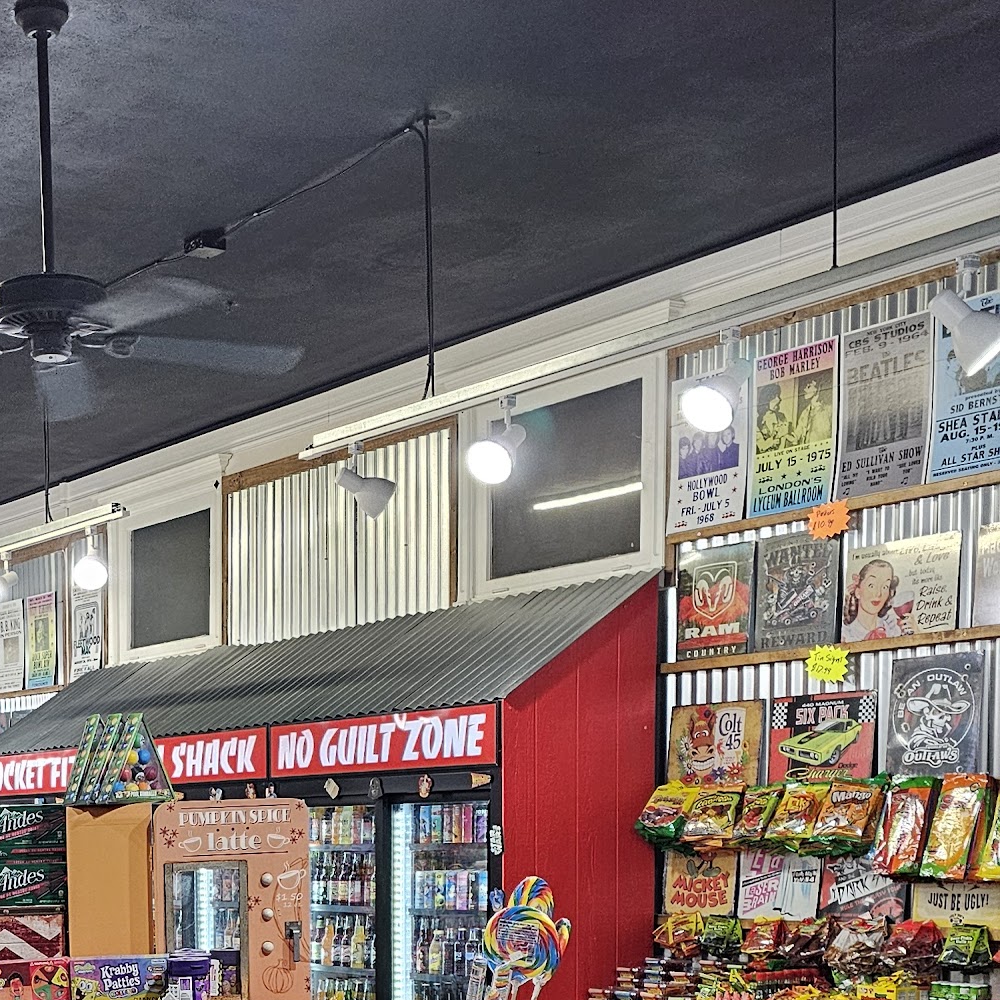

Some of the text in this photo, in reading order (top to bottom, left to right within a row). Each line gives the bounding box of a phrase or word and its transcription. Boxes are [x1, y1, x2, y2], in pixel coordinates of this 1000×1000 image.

[845, 346, 873, 358] FEB.
[898, 329, 930, 344] 1964
[848, 321, 925, 350] CBS STUDIOS
[756, 340, 835, 371] GEORGE HARRISON
[769, 357, 820, 381] BOB MARLEY
[847, 350, 927, 382] BEATLES
[950, 402, 964, 415] SID
[938, 416, 967, 434] SHEA
[940, 430, 969, 443] AUG.
[794, 445, 810, 454] STAGE
[971, 443, 986, 451] PLUS
[756, 449, 831, 474] JULY 15 1975
[842, 445, 924, 473] ED SULLIVAN SHOW
[941, 449, 985, 467] ALL STAR
[687, 473, 728, 492] HOLLYWOOD
[758, 476, 822, 494] LONDON'S
[692, 489, 720, 502] BOWL
[753, 485, 824, 513] LYCEUM BALLROOM
[696, 513, 715, 525] 1968
[914, 551, 950, 566] & Love
[916, 597, 953, 611] Drink &
[917, 610, 952, 625] Repeat
[685, 622, 740, 639] RAM
[761, 629, 829, 648] REWARD
[73, 636, 101, 649] FLEETWOOD
[686, 645, 738, 659] COUNTRY
[927, 671, 966, 697] OUTLAW
[817, 699, 844, 708] MAGNUM
[718, 711, 743, 736] Colt
[795, 703, 850, 726] SIX PACK
[277, 713, 487, 770] NO GUILT ZONE
[724, 732, 741, 750] 45
[171, 735, 257, 779] SHACK
[902, 748, 960, 766] OUTLAWS
[784, 766, 850, 781] Charger
[831, 790, 872, 803] Mango
[0, 810, 44, 834] Andes
[178, 808, 291, 827] PUMPKIN SPICE
[206, 831, 262, 852] latte
[0, 868, 45, 891] Andes
[672, 872, 731, 892] MICKEY
[670, 889, 728, 910] MOUSE
[928, 891, 989, 911] JUST BE UGLY!
[101, 962, 139, 978] Krabby
[102, 975, 141, 992] Patties
